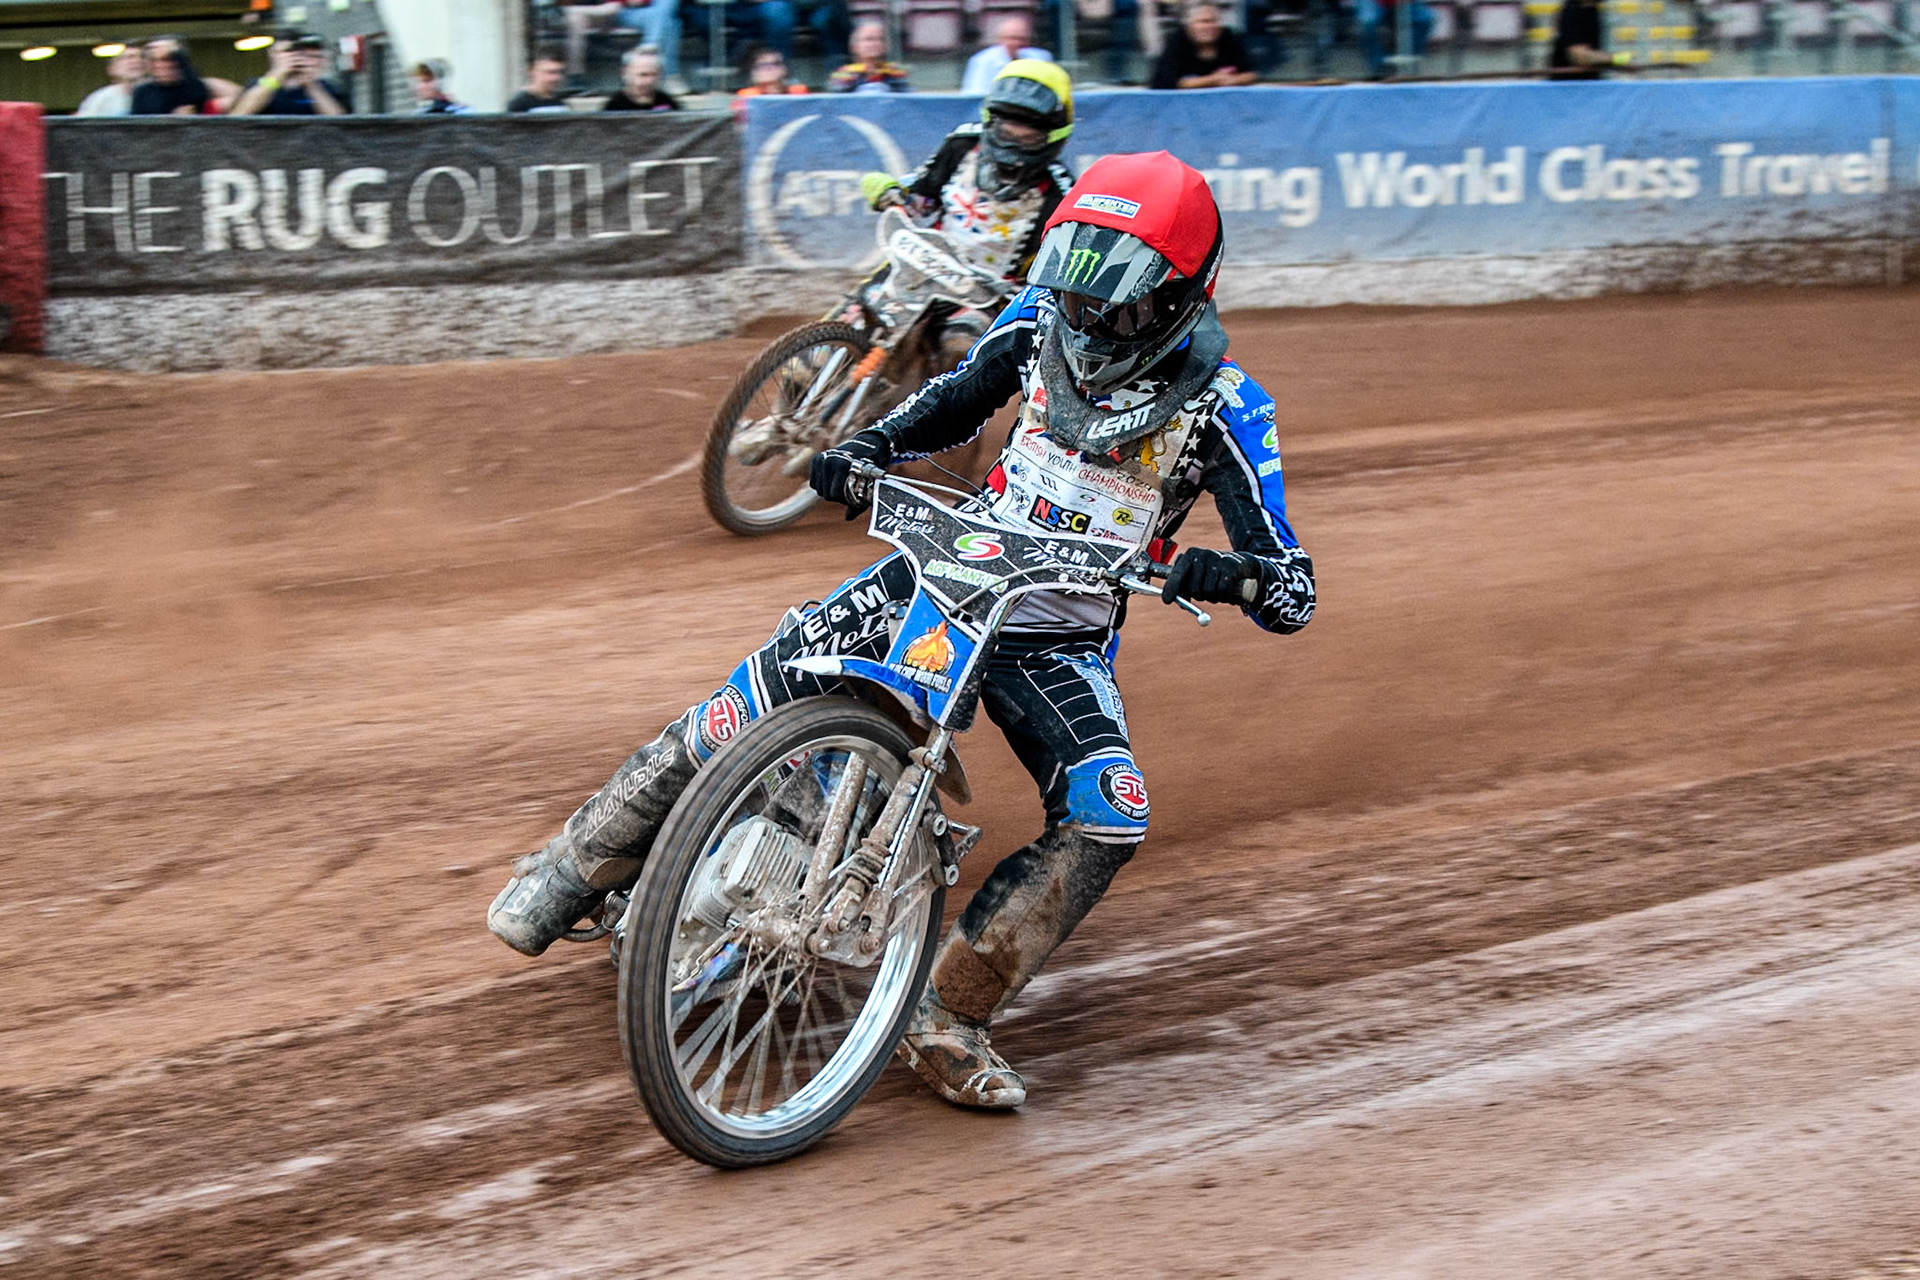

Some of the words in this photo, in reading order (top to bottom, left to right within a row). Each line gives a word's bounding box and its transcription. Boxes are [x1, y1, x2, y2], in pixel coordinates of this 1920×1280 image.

[1336, 146, 1526, 209] World
[1539, 145, 1698, 202] Class
[1714, 138, 1890, 197] Travel
[202, 167, 391, 252] RUG
[407, 156, 721, 248] OUTLET
[1047, 452, 1077, 473] YOUTH
[1078, 469, 1156, 504] CHAMPIONSHIP
[1034, 498, 1087, 532] NSSC
[712, 697, 737, 741] STS
[725, 686, 750, 731] STAKEFOR
[1115, 777, 1148, 800] STS
